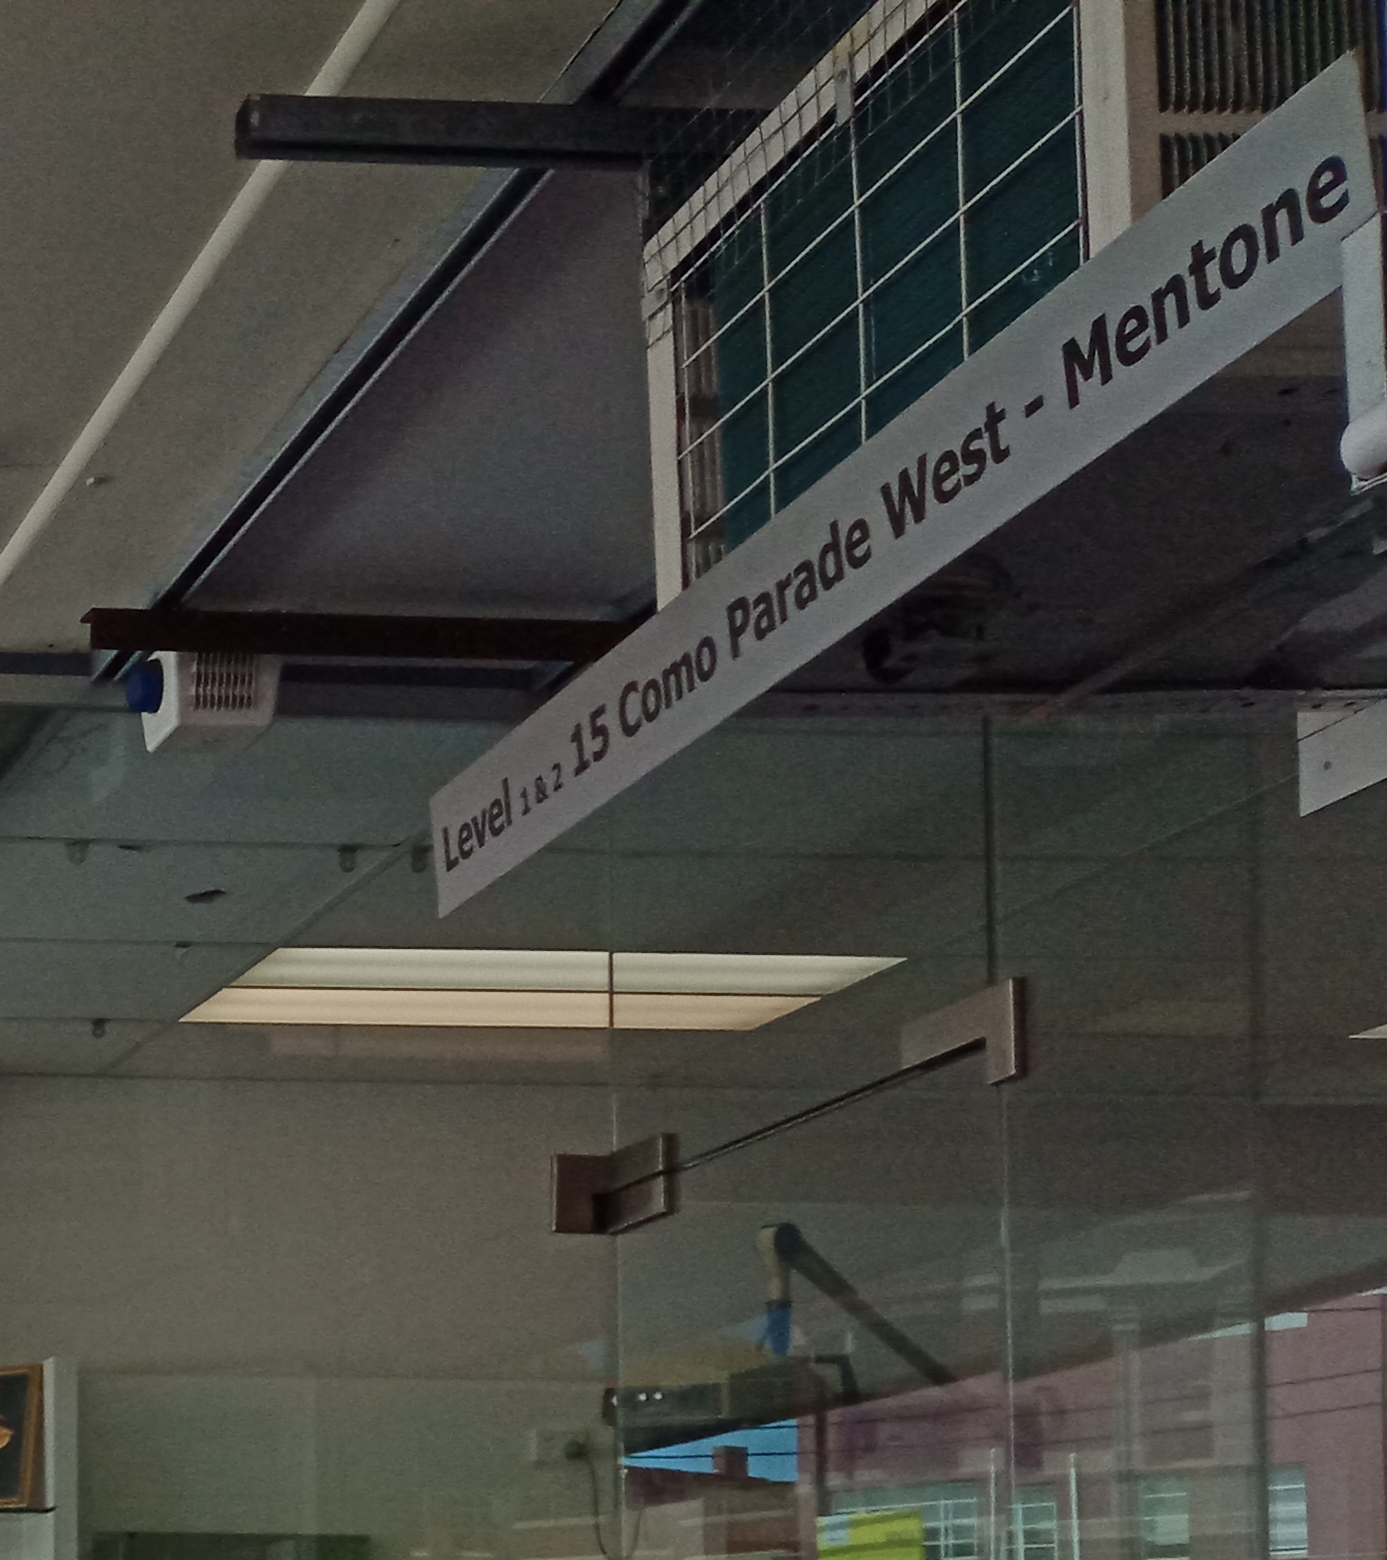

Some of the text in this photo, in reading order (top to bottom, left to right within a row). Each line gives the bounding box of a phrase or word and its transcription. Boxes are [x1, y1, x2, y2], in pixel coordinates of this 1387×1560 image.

[441, 777, 513, 873] Level
[520, 786, 531, 817] 1
[534, 775, 549, 804] &
[552, 762, 565, 793] 2
[570, 703, 609, 777] 15
[619, 635, 718, 738] Como
[727, 517, 873, 659] Parade
[879, 401, 1011, 541] West
[1061, 154, 1350, 410] Mentone
